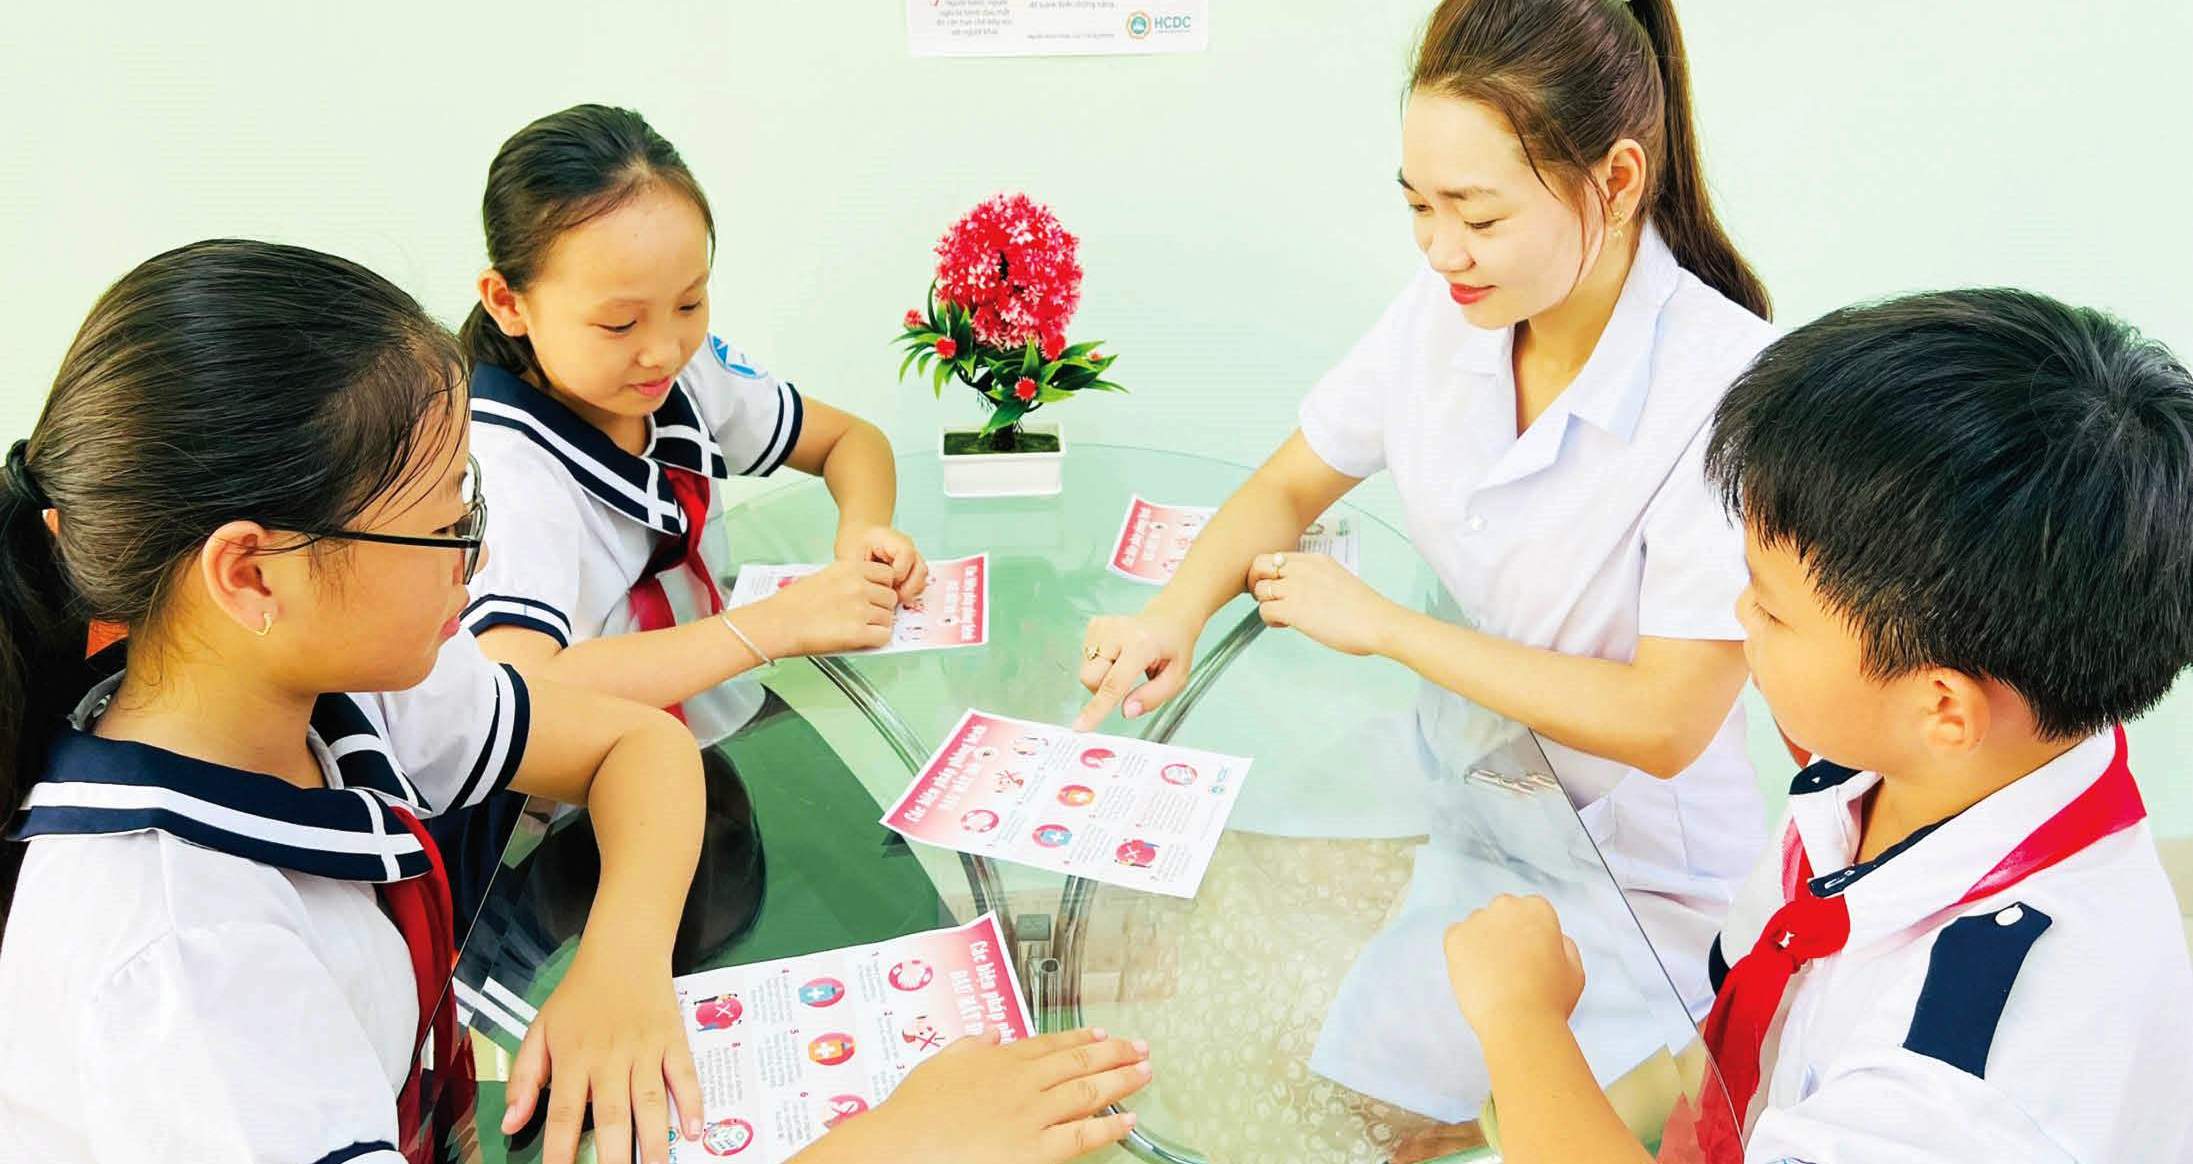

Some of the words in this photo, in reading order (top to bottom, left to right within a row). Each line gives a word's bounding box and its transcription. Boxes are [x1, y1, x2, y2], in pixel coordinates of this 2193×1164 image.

[1154, 16, 1192, 29] HCDC
[970, 940, 989, 963] Các
[976, 962, 997, 990] biện
[981, 991, 1008, 1019] pháp
